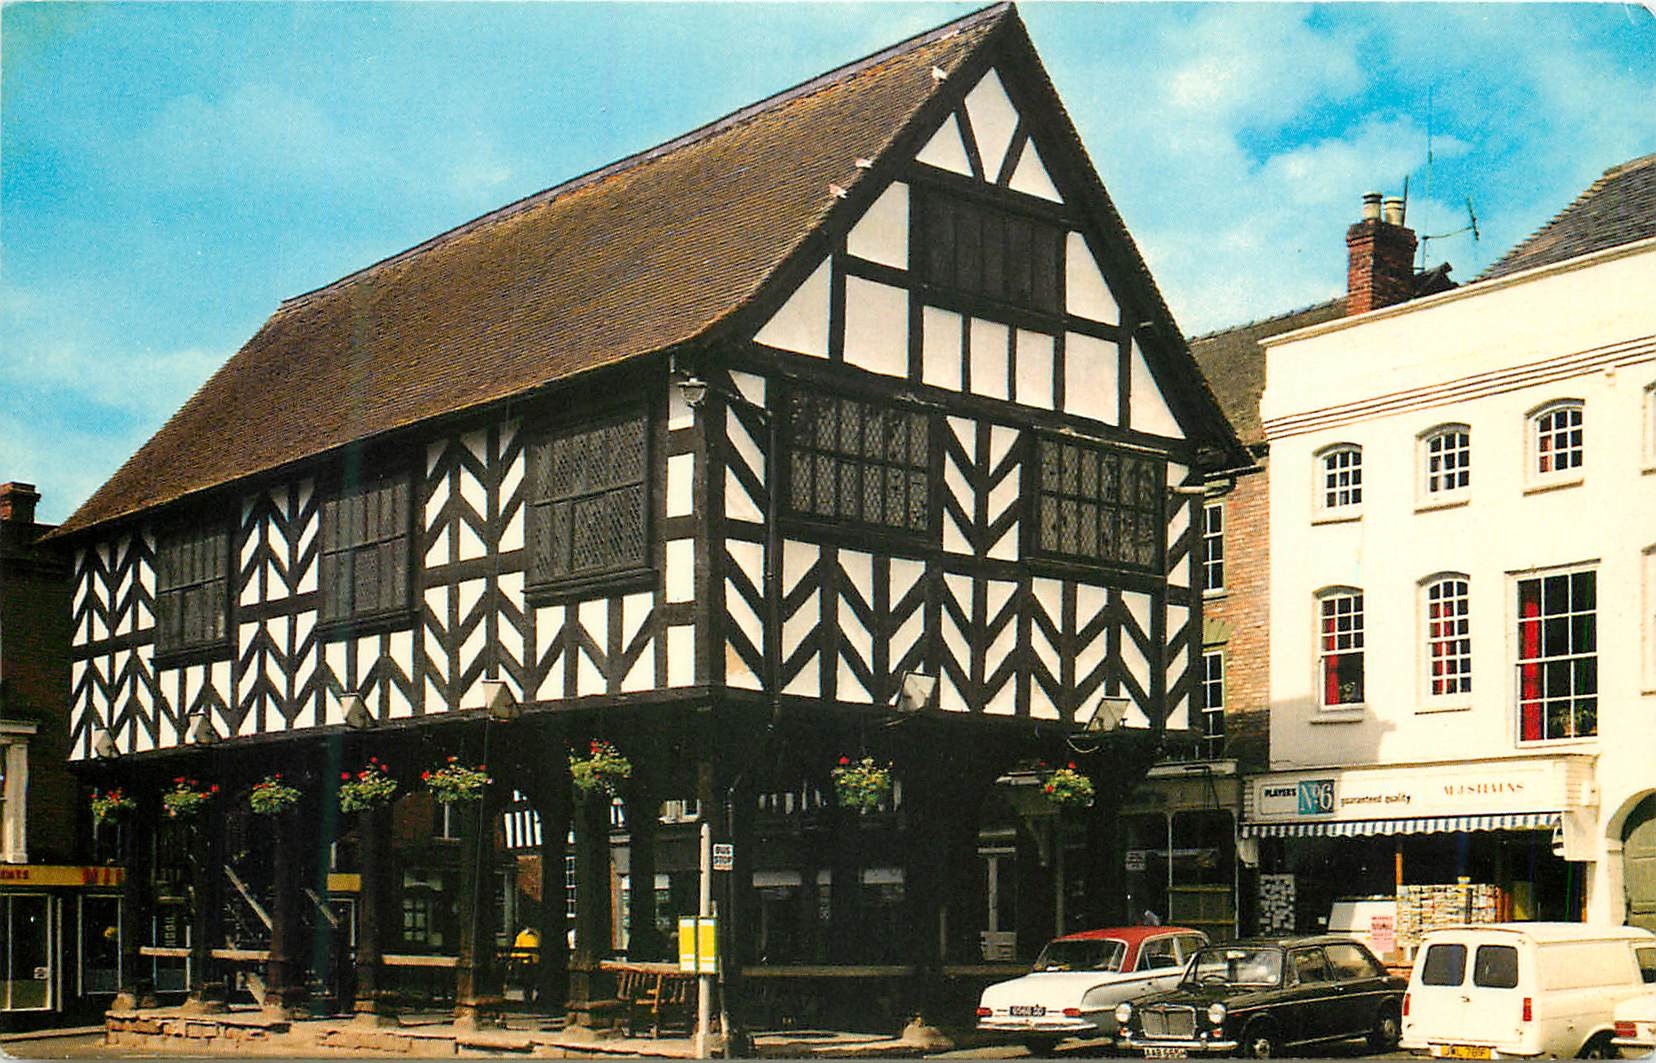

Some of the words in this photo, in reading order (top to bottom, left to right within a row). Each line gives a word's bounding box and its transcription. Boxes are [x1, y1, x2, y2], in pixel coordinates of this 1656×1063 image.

[1467, 782, 1525, 795] STEVENS
[1340, 794, 1382, 807] guaranteed
[1384, 791, 1411, 804] quality
[715, 846, 731, 854] BUS
[714, 855, 732, 864] STOP
